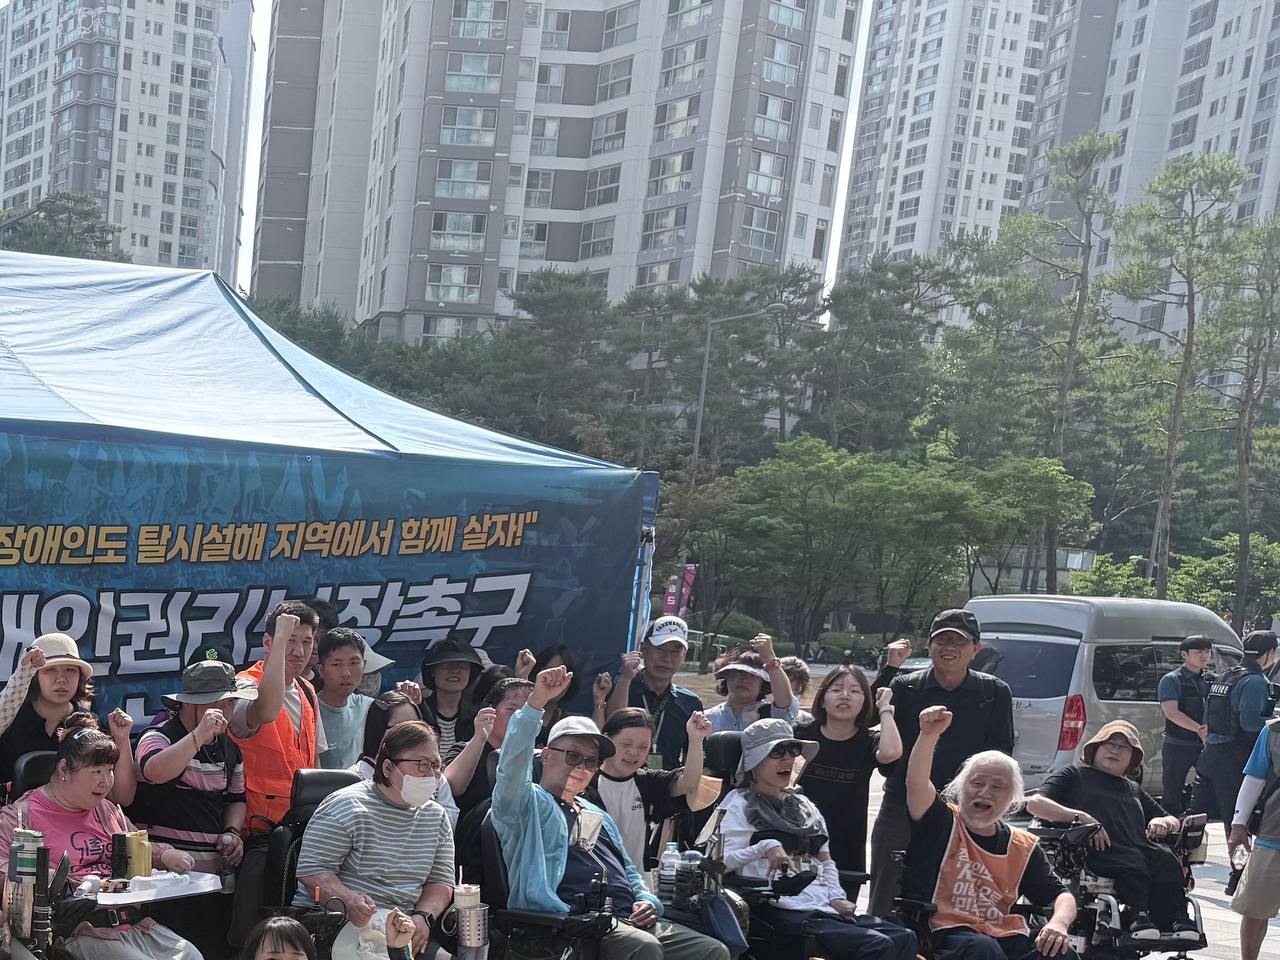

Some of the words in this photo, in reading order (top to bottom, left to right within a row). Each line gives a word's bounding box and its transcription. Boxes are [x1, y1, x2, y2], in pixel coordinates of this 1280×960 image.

[136, 521, 271, 563] 탈시설해
[274, 518, 395, 560] 지역에서
[398, 516, 456, 555] 함께
[460, 510, 539, 552] 살자!"
